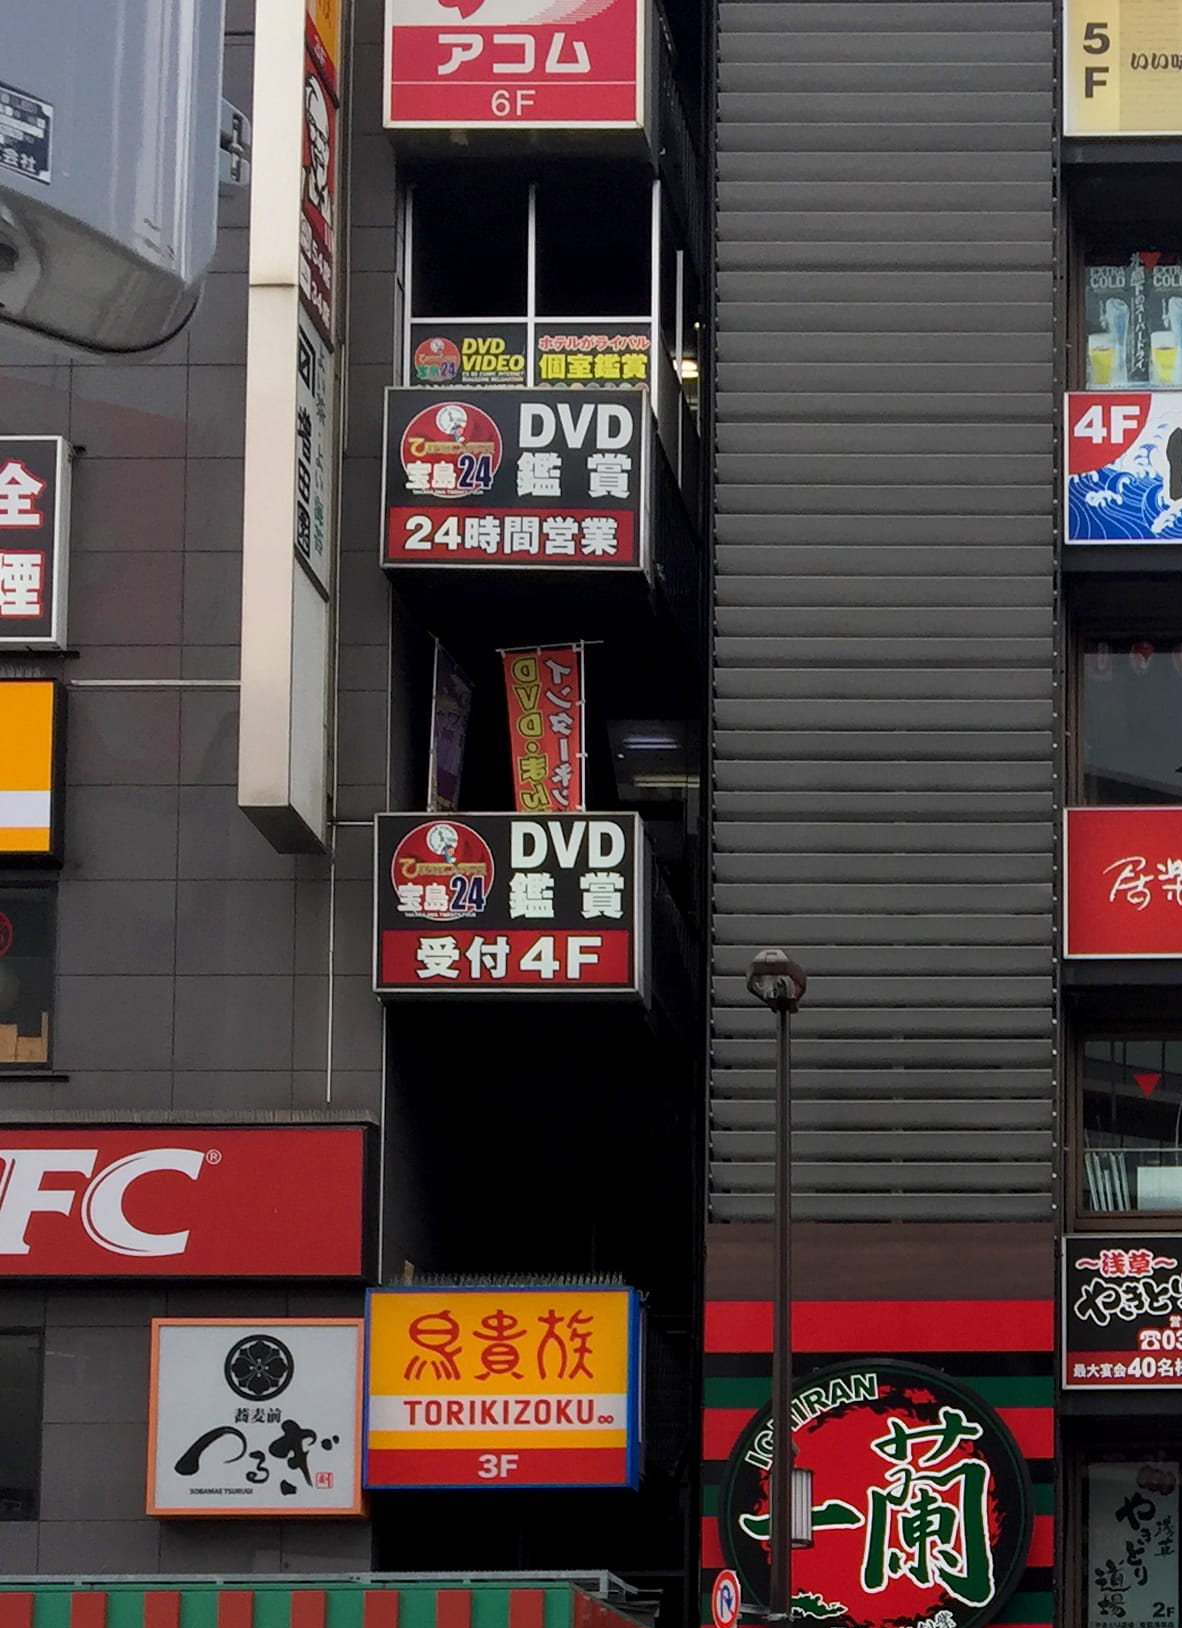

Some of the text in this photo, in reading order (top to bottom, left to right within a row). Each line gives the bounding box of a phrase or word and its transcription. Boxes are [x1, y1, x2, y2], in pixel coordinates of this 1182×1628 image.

[438, 33, 591, 75] アコム
[491, 90, 536, 117] 6F
[1091, 275, 1126, 289] COLD
[461, 354, 525, 372] VIDEO
[462, 338, 505, 355] DVD
[538, 335, 651, 352] ホテルがライバル
[538, 353, 648, 379] 個室鑑賞
[519, 403, 634, 449] DVD
[1073, 404, 1143, 444] 4F
[517, 452, 632, 498] 鑑賞
[404, 515, 618, 555] 24時間営業
[511, 821, 626, 869] DVD
[509, 872, 625, 919] 鑑賞
[416, 935, 603, 980] 受付4F
[0, 1148, 206, 1257] FC
[403, 1309, 594, 1380] 鳥貴族
[403, 1400, 594, 1426] TORIKIZOKU
[745, 1373, 879, 1471] ICIRAN
[174, 1419, 340, 1496] つるぎ
[478, 1454, 519, 1478] 3F
[1152, 1602, 1175, 1618] 2F
